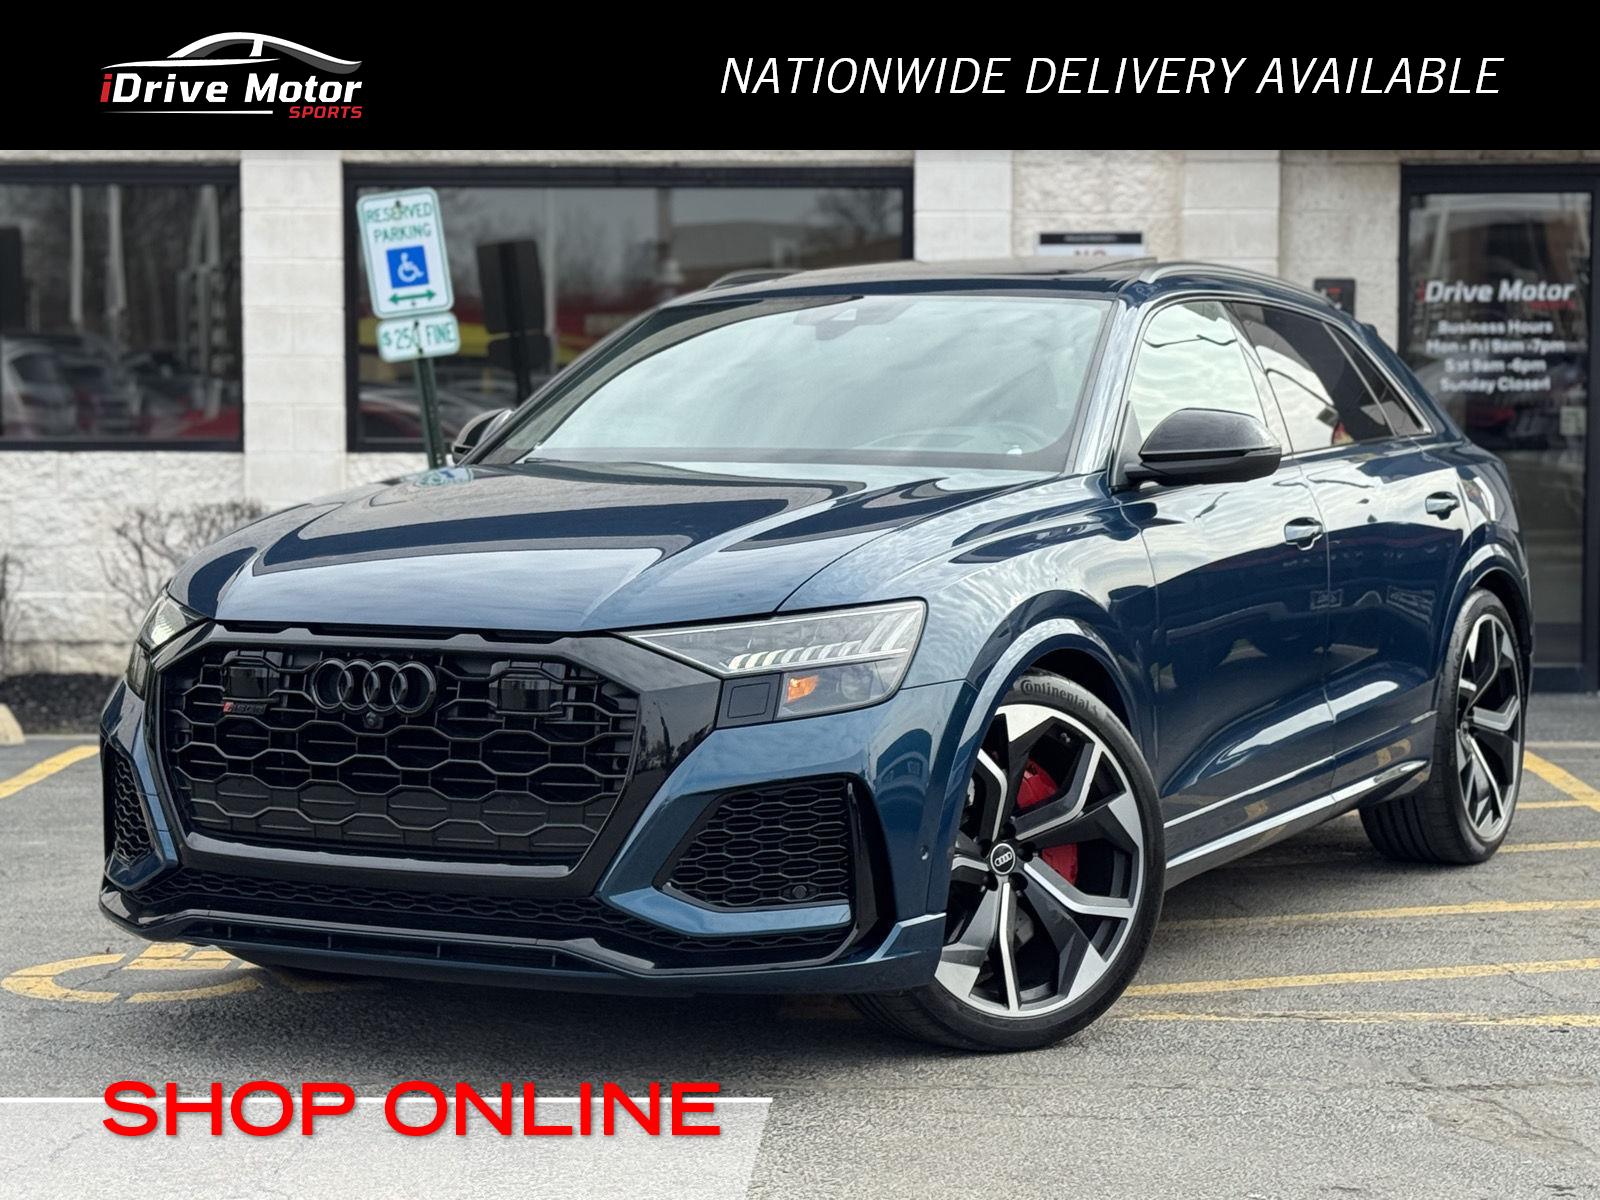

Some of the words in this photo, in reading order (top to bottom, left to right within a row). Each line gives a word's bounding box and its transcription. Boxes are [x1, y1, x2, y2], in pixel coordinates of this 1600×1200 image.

[364, 202, 434, 225] RESERVED
[373, 222, 432, 244] PARKING
[1497, 278, 1576, 303] Motor
[425, 322, 457, 346] FINE
[1438, 319, 1506, 335] Business
[1507, 319, 1554, 335] Hours
[1440, 376, 1496, 395] Sunday
[1497, 375, 1552, 392] Closed
[1020, 679, 1090, 711] Continental
